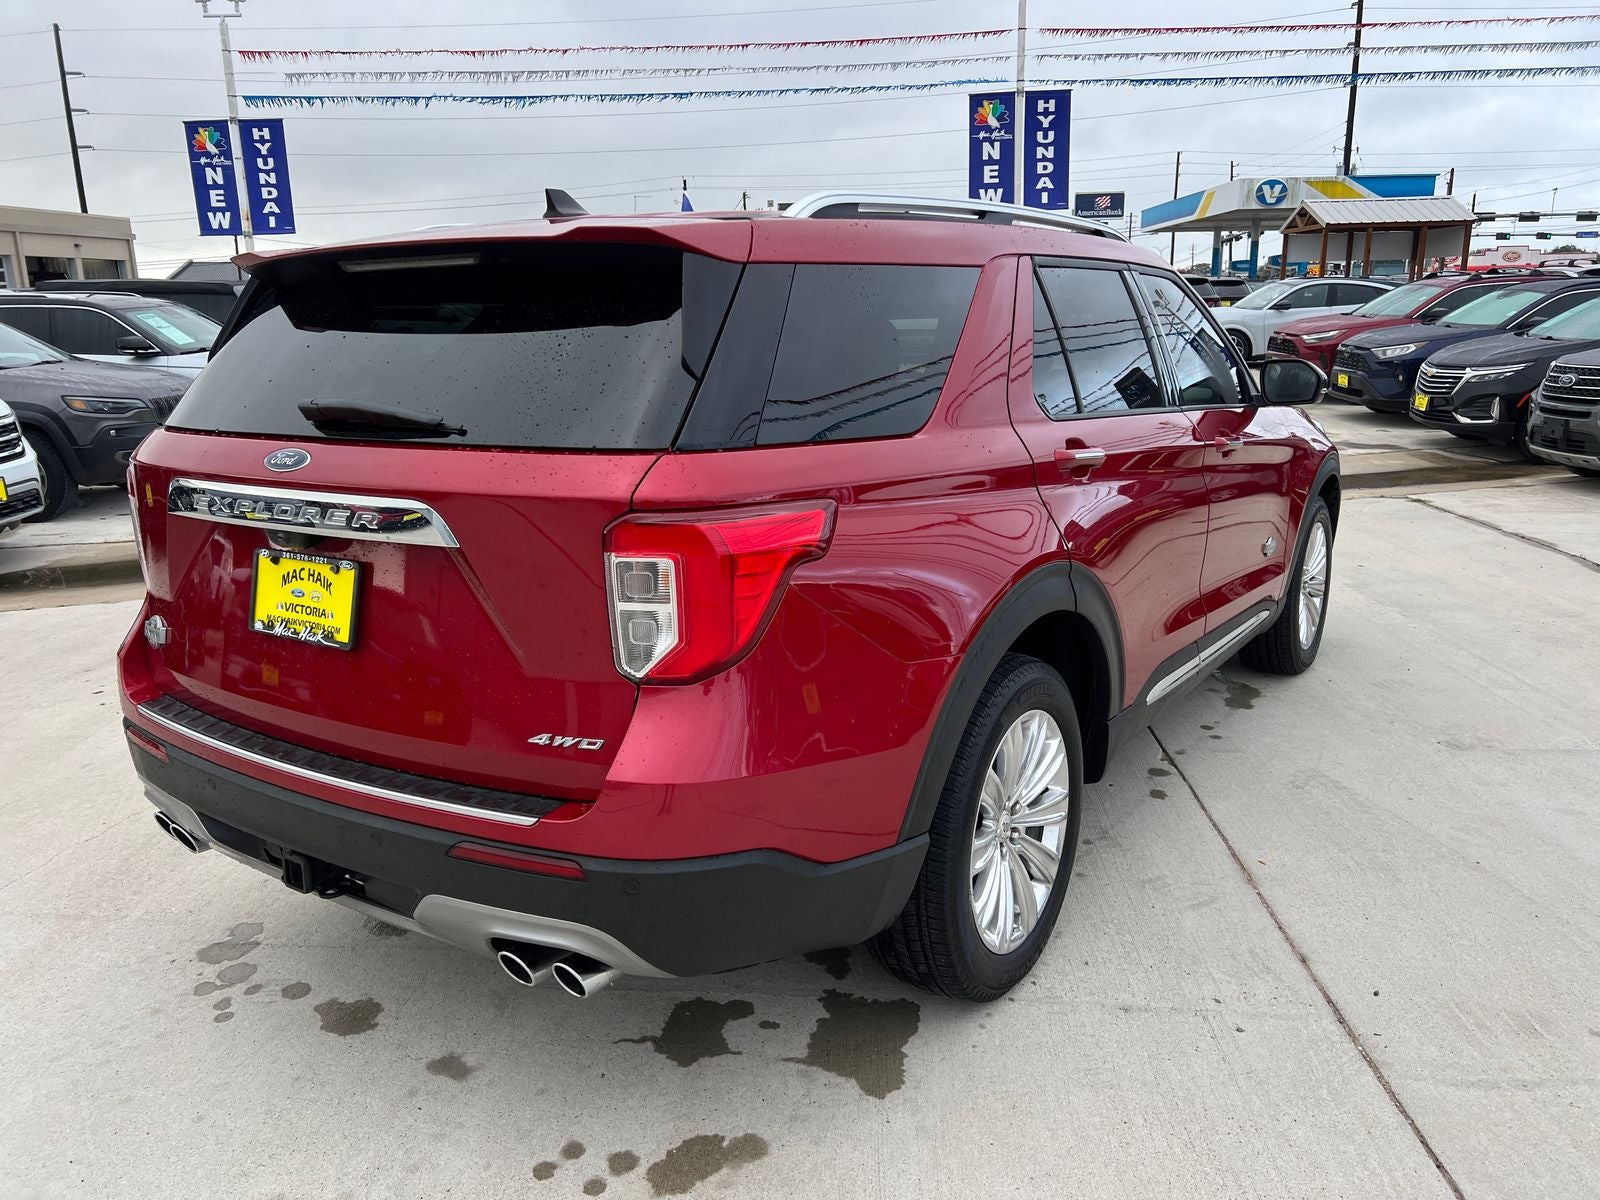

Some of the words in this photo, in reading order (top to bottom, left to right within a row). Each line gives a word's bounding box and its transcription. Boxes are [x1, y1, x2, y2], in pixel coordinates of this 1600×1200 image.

[1035, 99, 1056, 204] HYUNDAI
[251, 127, 281, 228] HYUNDAI
[978, 141, 1004, 203] NEW
[204, 167, 231, 229] NEW
[270, 451, 298, 466] Ford
[192, 494, 382, 529] EXPLORER
[281, 551, 328, 564] 361-576-1221
[281, 567, 306, 588] MAC
[307, 567, 333, 596] HAIK
[284, 602, 327, 619] VICTORIA
[273, 621, 298, 637] Mac
[297, 626, 330, 644] Haik
[527, 733, 605, 750] 4WD
